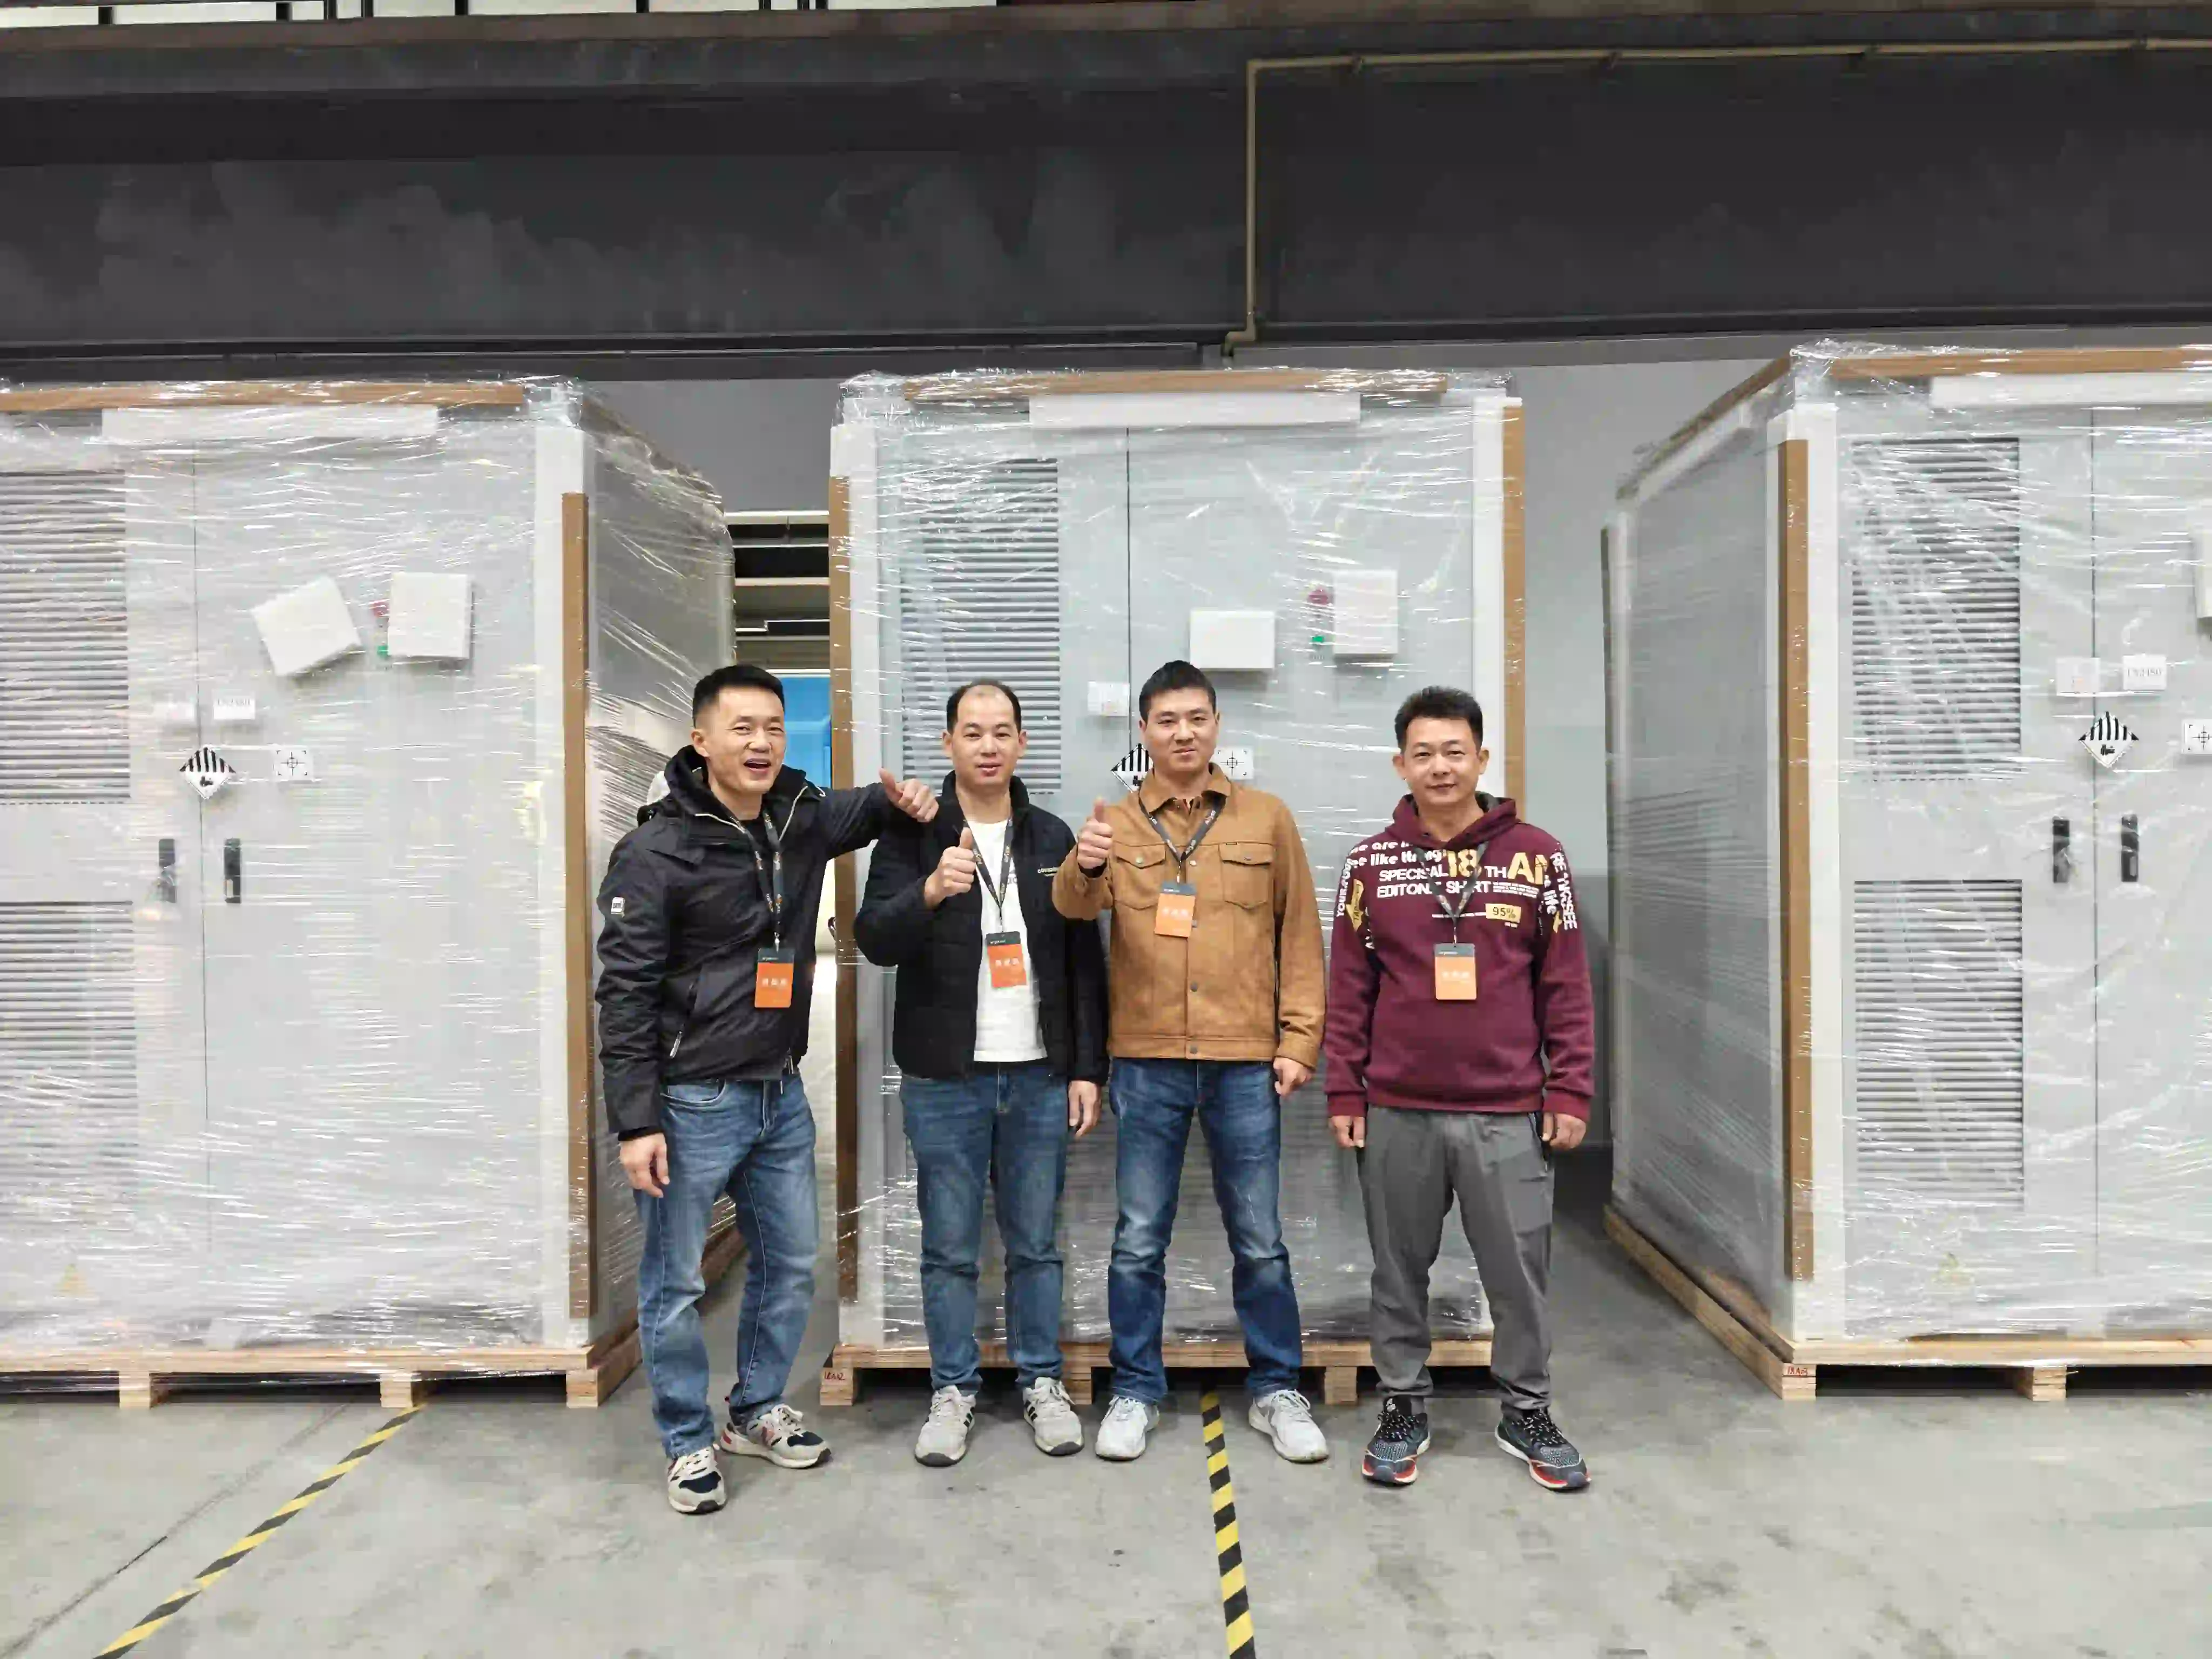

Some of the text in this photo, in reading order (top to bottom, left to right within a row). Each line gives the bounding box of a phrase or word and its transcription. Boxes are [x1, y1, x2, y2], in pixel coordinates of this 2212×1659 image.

[1370, 853, 1398, 866] like
[1484, 866, 1507, 878] TH
[1445, 881, 1491, 894] SHRT
[1493, 907, 1516, 919] 95%
